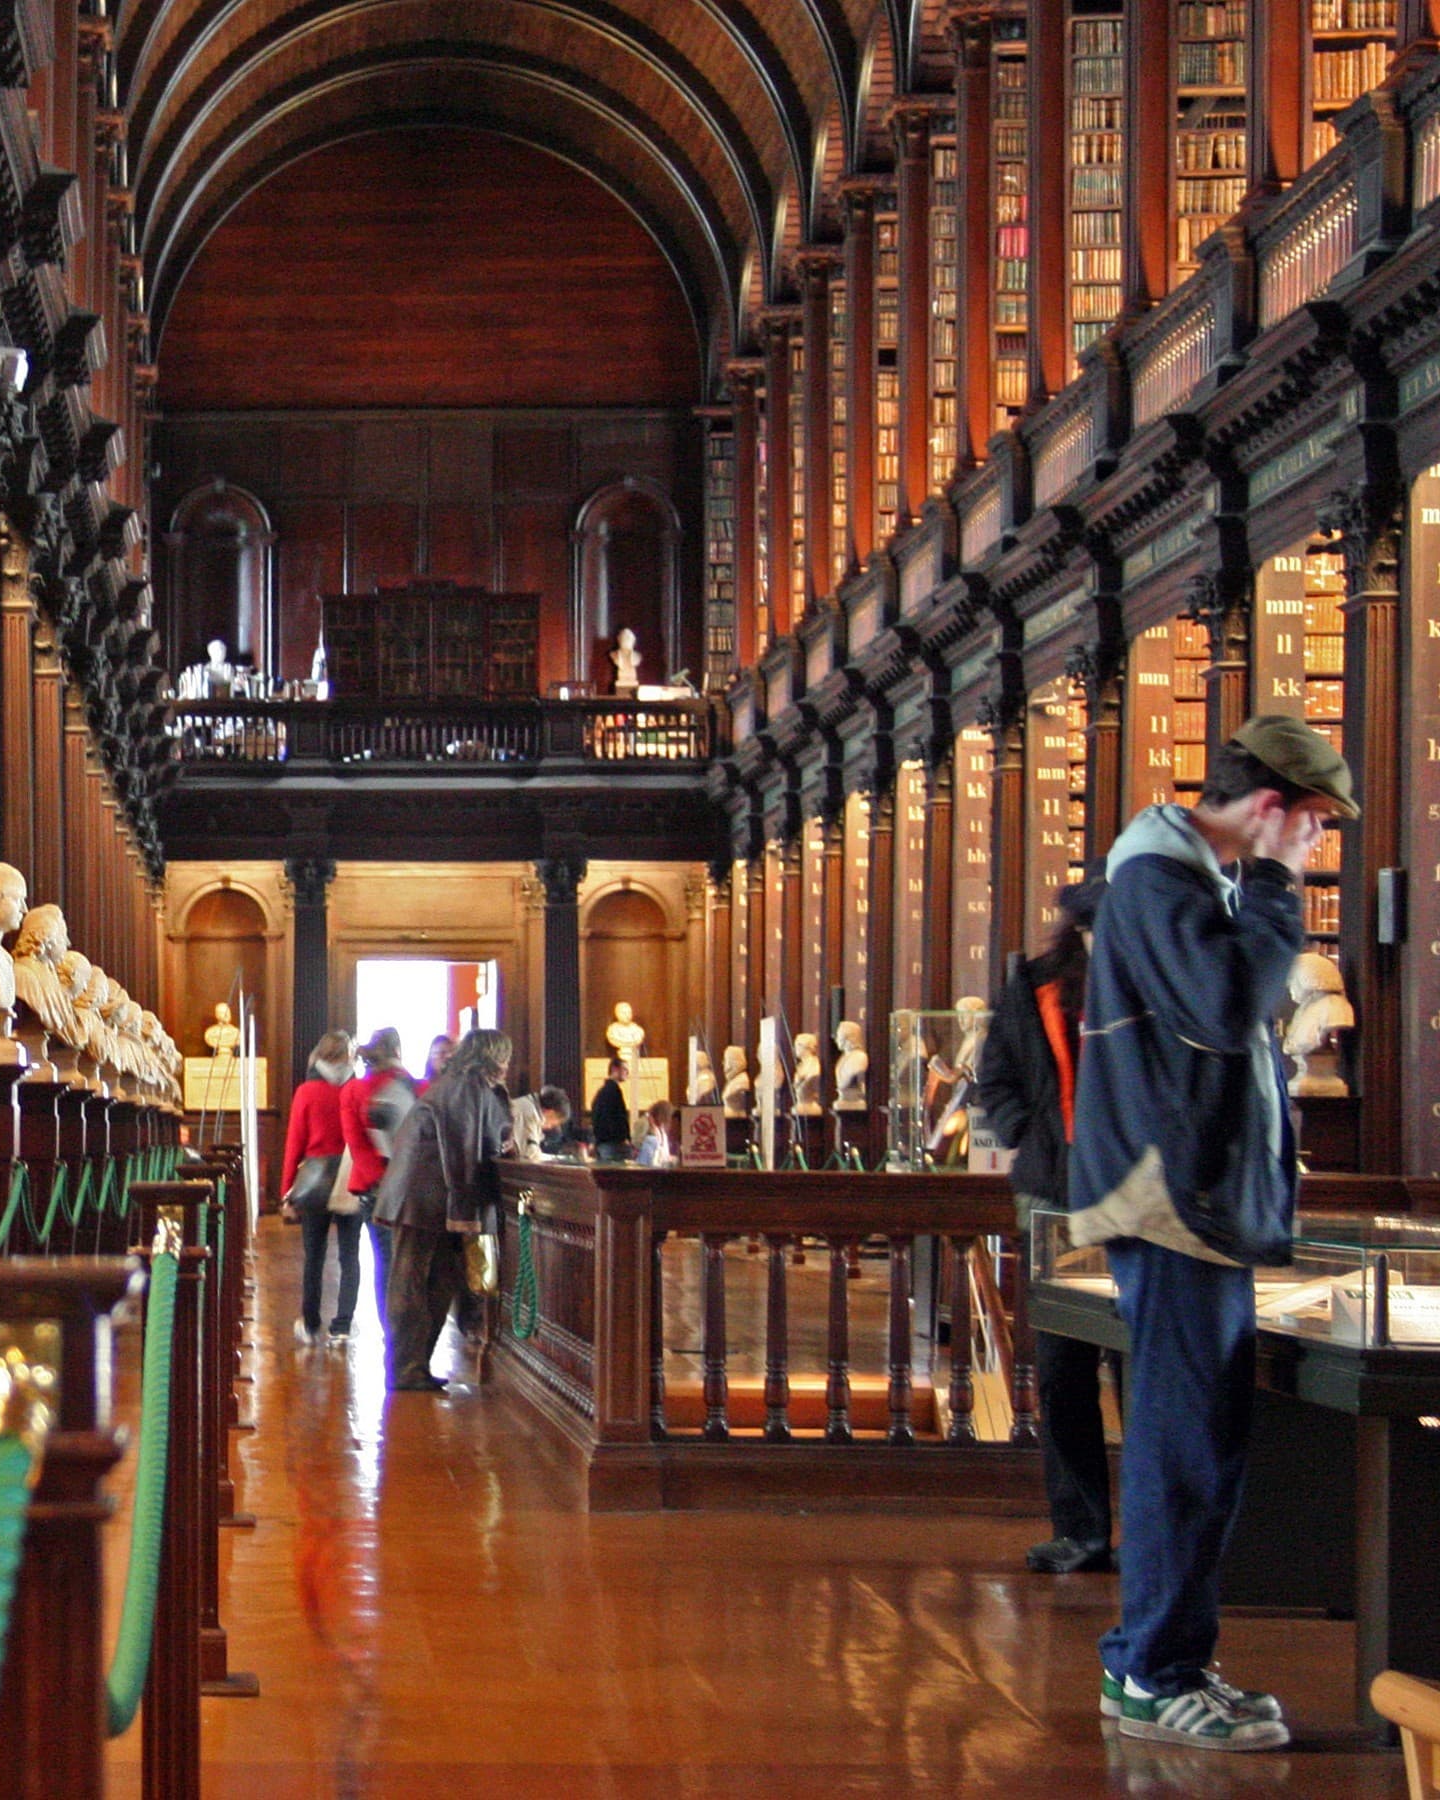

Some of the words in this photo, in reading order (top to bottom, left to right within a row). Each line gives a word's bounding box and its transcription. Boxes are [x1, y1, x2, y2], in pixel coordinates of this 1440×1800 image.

[1274, 556, 1302, 572] nn
[1266, 600, 1303, 615] mm
[1138, 672, 1170, 686] mm
[1272, 677, 1302, 697] kk
[1044, 736, 1066, 748] nn
[1148, 748, 1172, 767] kk
[1037, 767, 1066, 780] mm
[966, 782, 987, 798] kk
[1042, 830, 1065, 846] kk
